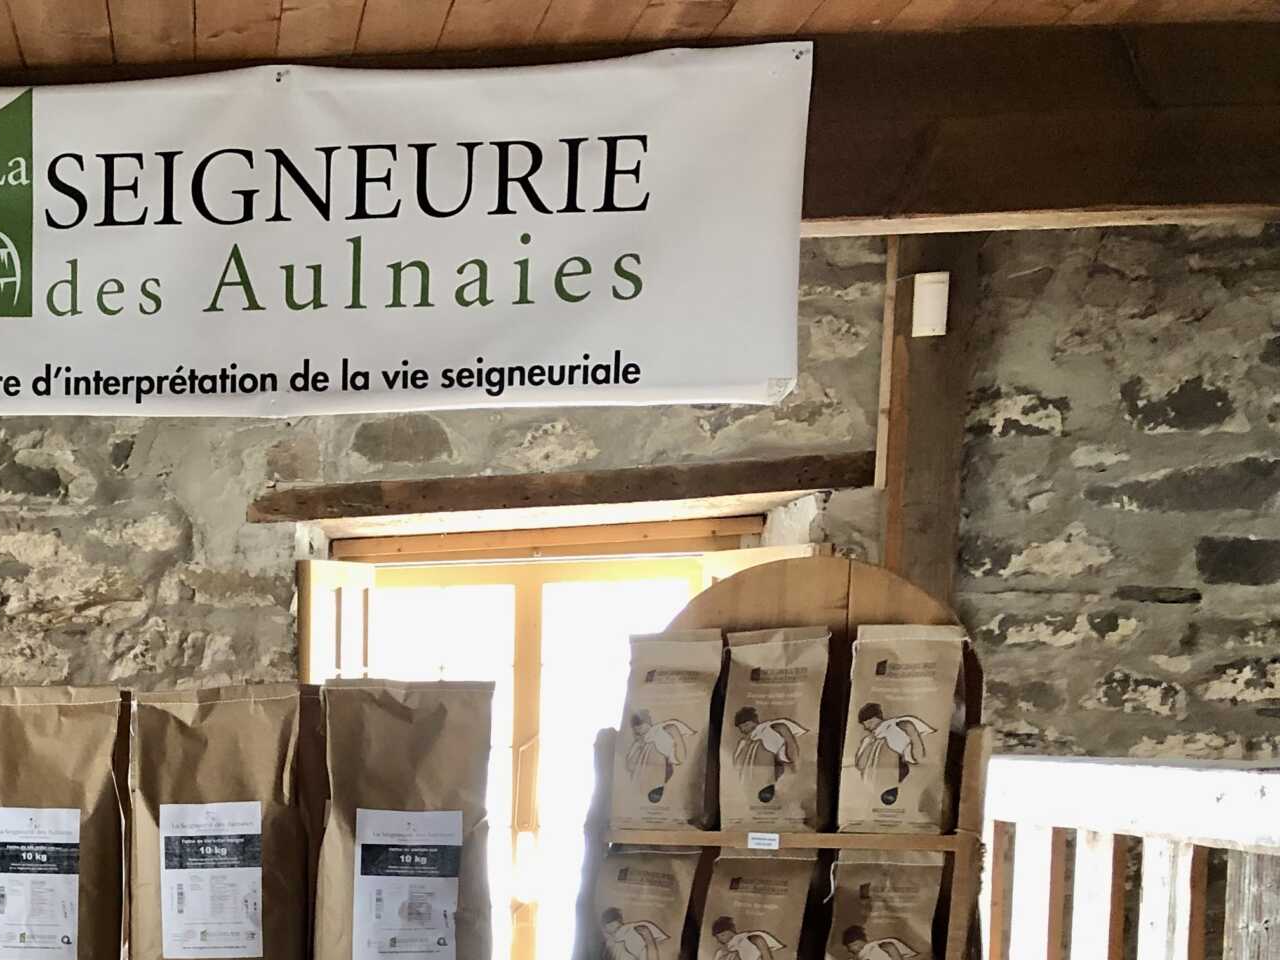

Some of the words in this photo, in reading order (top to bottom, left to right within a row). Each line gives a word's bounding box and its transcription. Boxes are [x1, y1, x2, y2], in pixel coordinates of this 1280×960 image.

[44, 134, 650, 230] SEIGNEURIE
[45, 258, 162, 317] des
[202, 232, 644, 314] Aulnaies
[31, 362, 279, 404] d'interprétation
[289, 358, 330, 392] de
[340, 357, 370, 391] la
[381, 359, 429, 390] vie
[440, 349, 641, 397] seigneuriale
[21, 852, 33, 860] 10
[35, 852, 47, 862] kg
[199, 846, 212, 855] 10
[214, 846, 228, 857] kg
[399, 855, 412, 863] 10
[414, 855, 428, 865] kg
